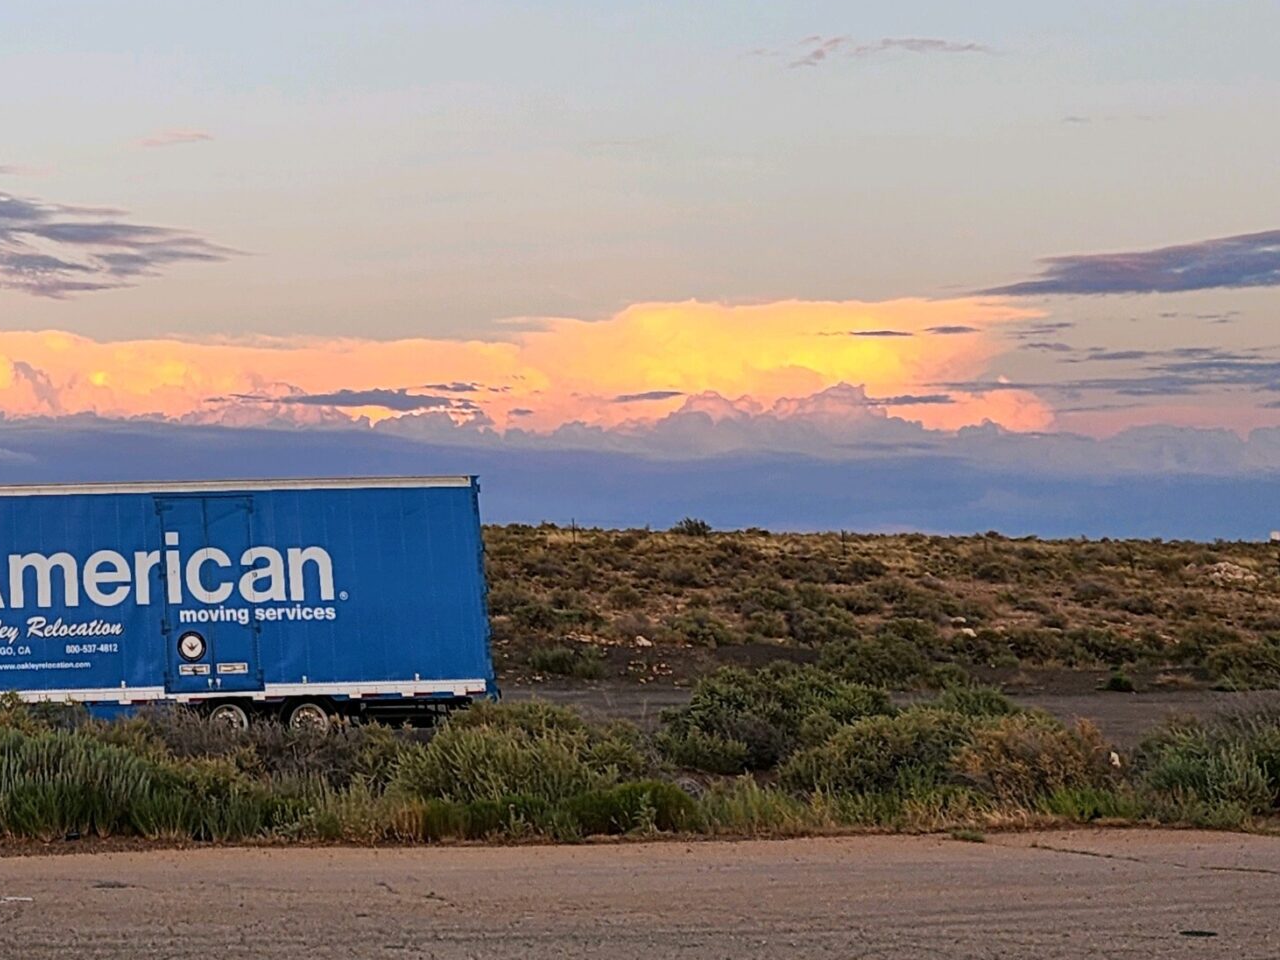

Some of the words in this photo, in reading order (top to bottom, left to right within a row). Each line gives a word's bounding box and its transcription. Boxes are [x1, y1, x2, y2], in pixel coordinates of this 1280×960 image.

[179, 605, 249, 624] moving
[255, 604, 336, 621] services
[27, 616, 123, 637] Relocation
[18, 646, 31, 655] CA
[65, 643, 118, 654] 800-537-4812
